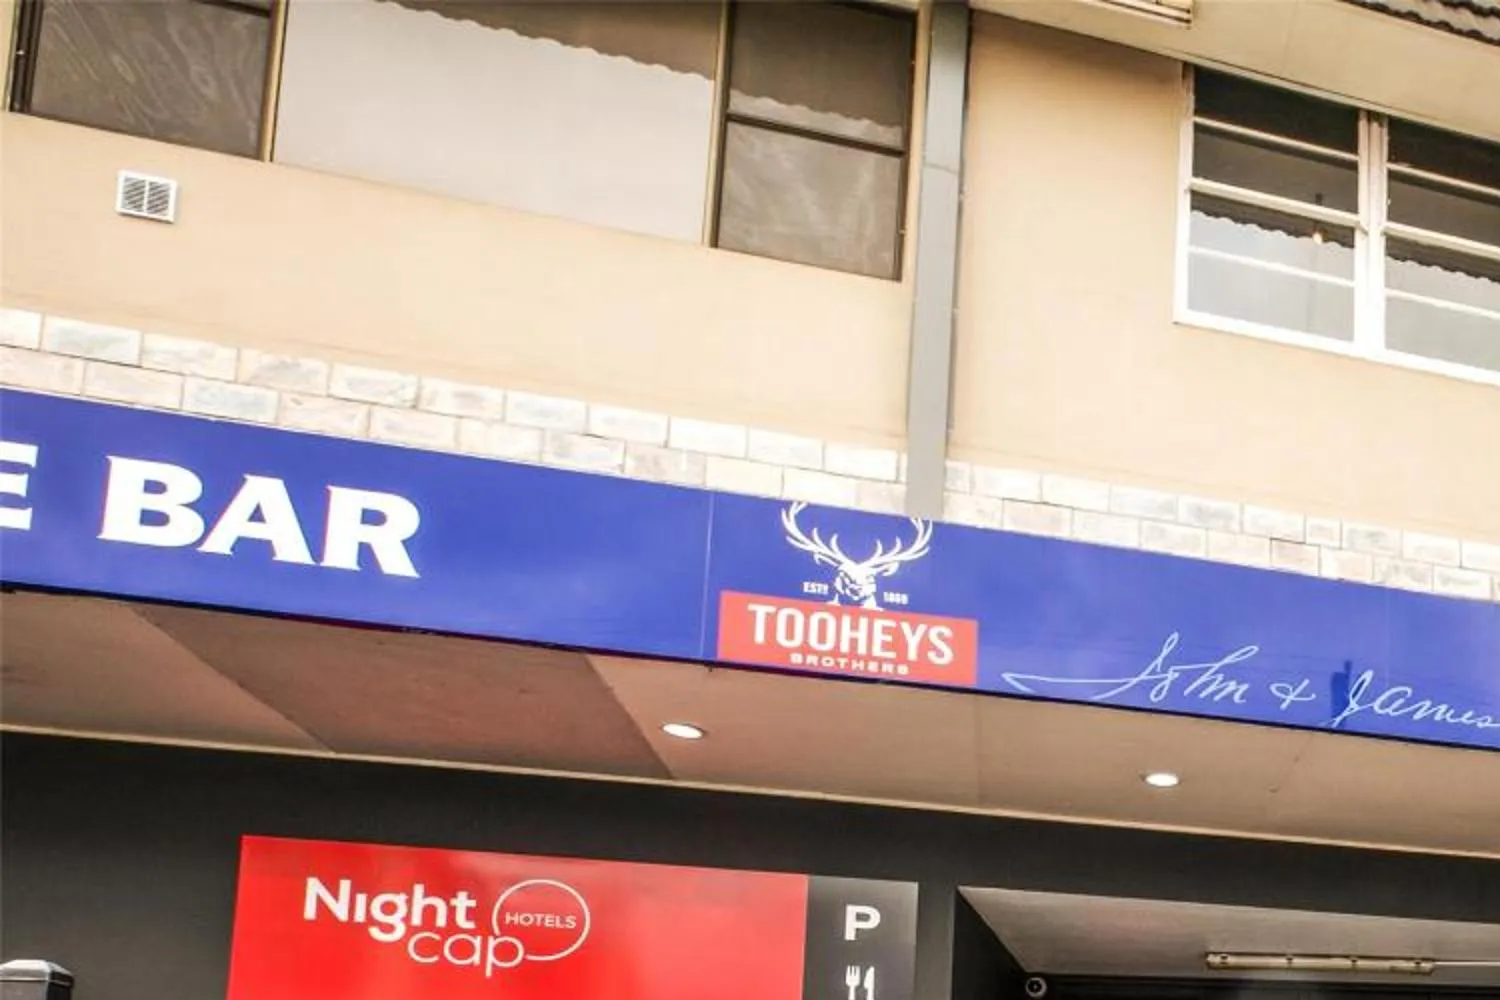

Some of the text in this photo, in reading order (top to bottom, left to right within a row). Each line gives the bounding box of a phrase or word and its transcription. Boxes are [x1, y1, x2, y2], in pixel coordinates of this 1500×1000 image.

[97, 455, 421, 578] BAR
[747, 603, 955, 666] TOOHEYS
[789, 653, 910, 676] BROTHERS
[1001, 632, 1258, 703] John
[304, 876, 477, 942] Night
[505, 911, 577, 929] HOTELS
[407, 931, 525, 977] cap
